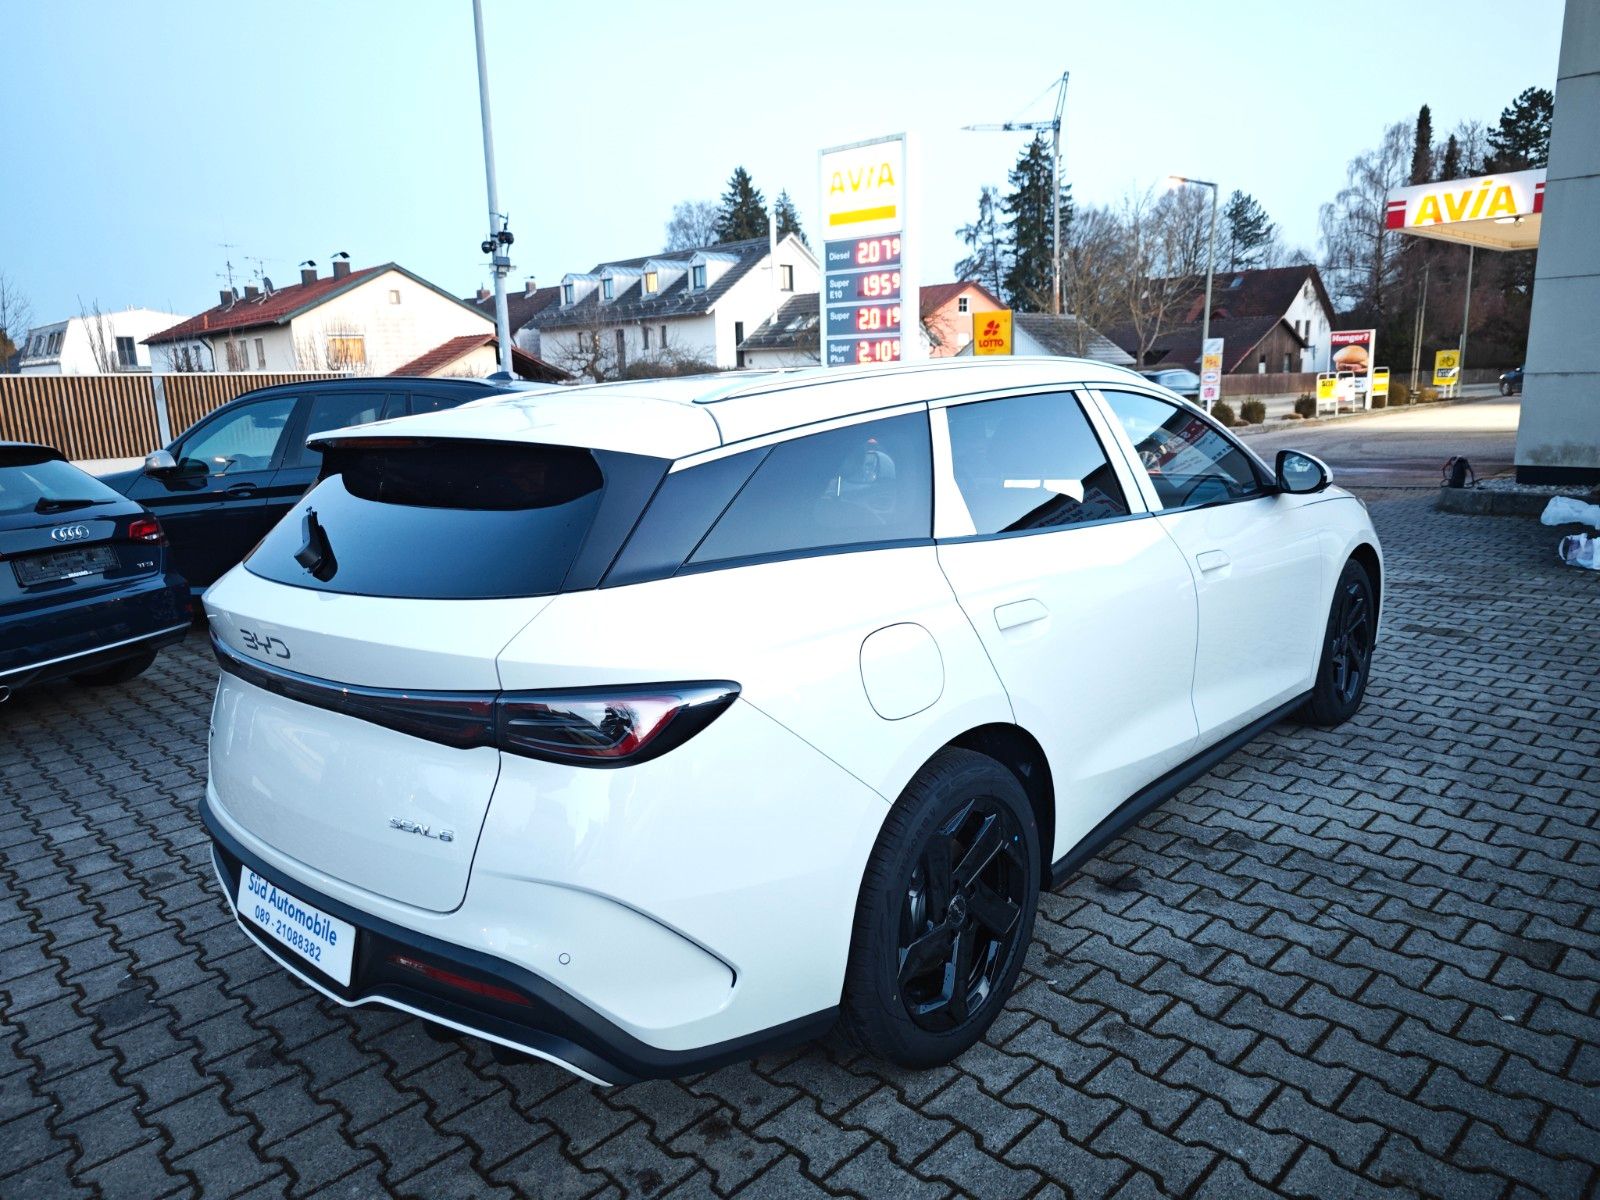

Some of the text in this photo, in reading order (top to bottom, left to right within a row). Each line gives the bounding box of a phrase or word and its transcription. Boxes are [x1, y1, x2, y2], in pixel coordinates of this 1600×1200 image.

[829, 162, 895, 195] AVIA
[828, 250, 851, 262] Diesel
[829, 279, 850, 290] Super
[829, 289, 843, 300] E10
[829, 311, 850, 322] Super
[978, 338, 1005, 348] LOTTO
[1332, 333, 1370, 344] Hunger?
[830, 343, 851, 354] Super
[830, 354, 846, 364] Plus
[239, 628, 291, 660] BYD
[390, 816, 438, 840] SEAL
[248, 871, 338, 947] Süd Automobile
[254, 904, 271, 926] 089
[275, 919, 323, 963] 21088382
